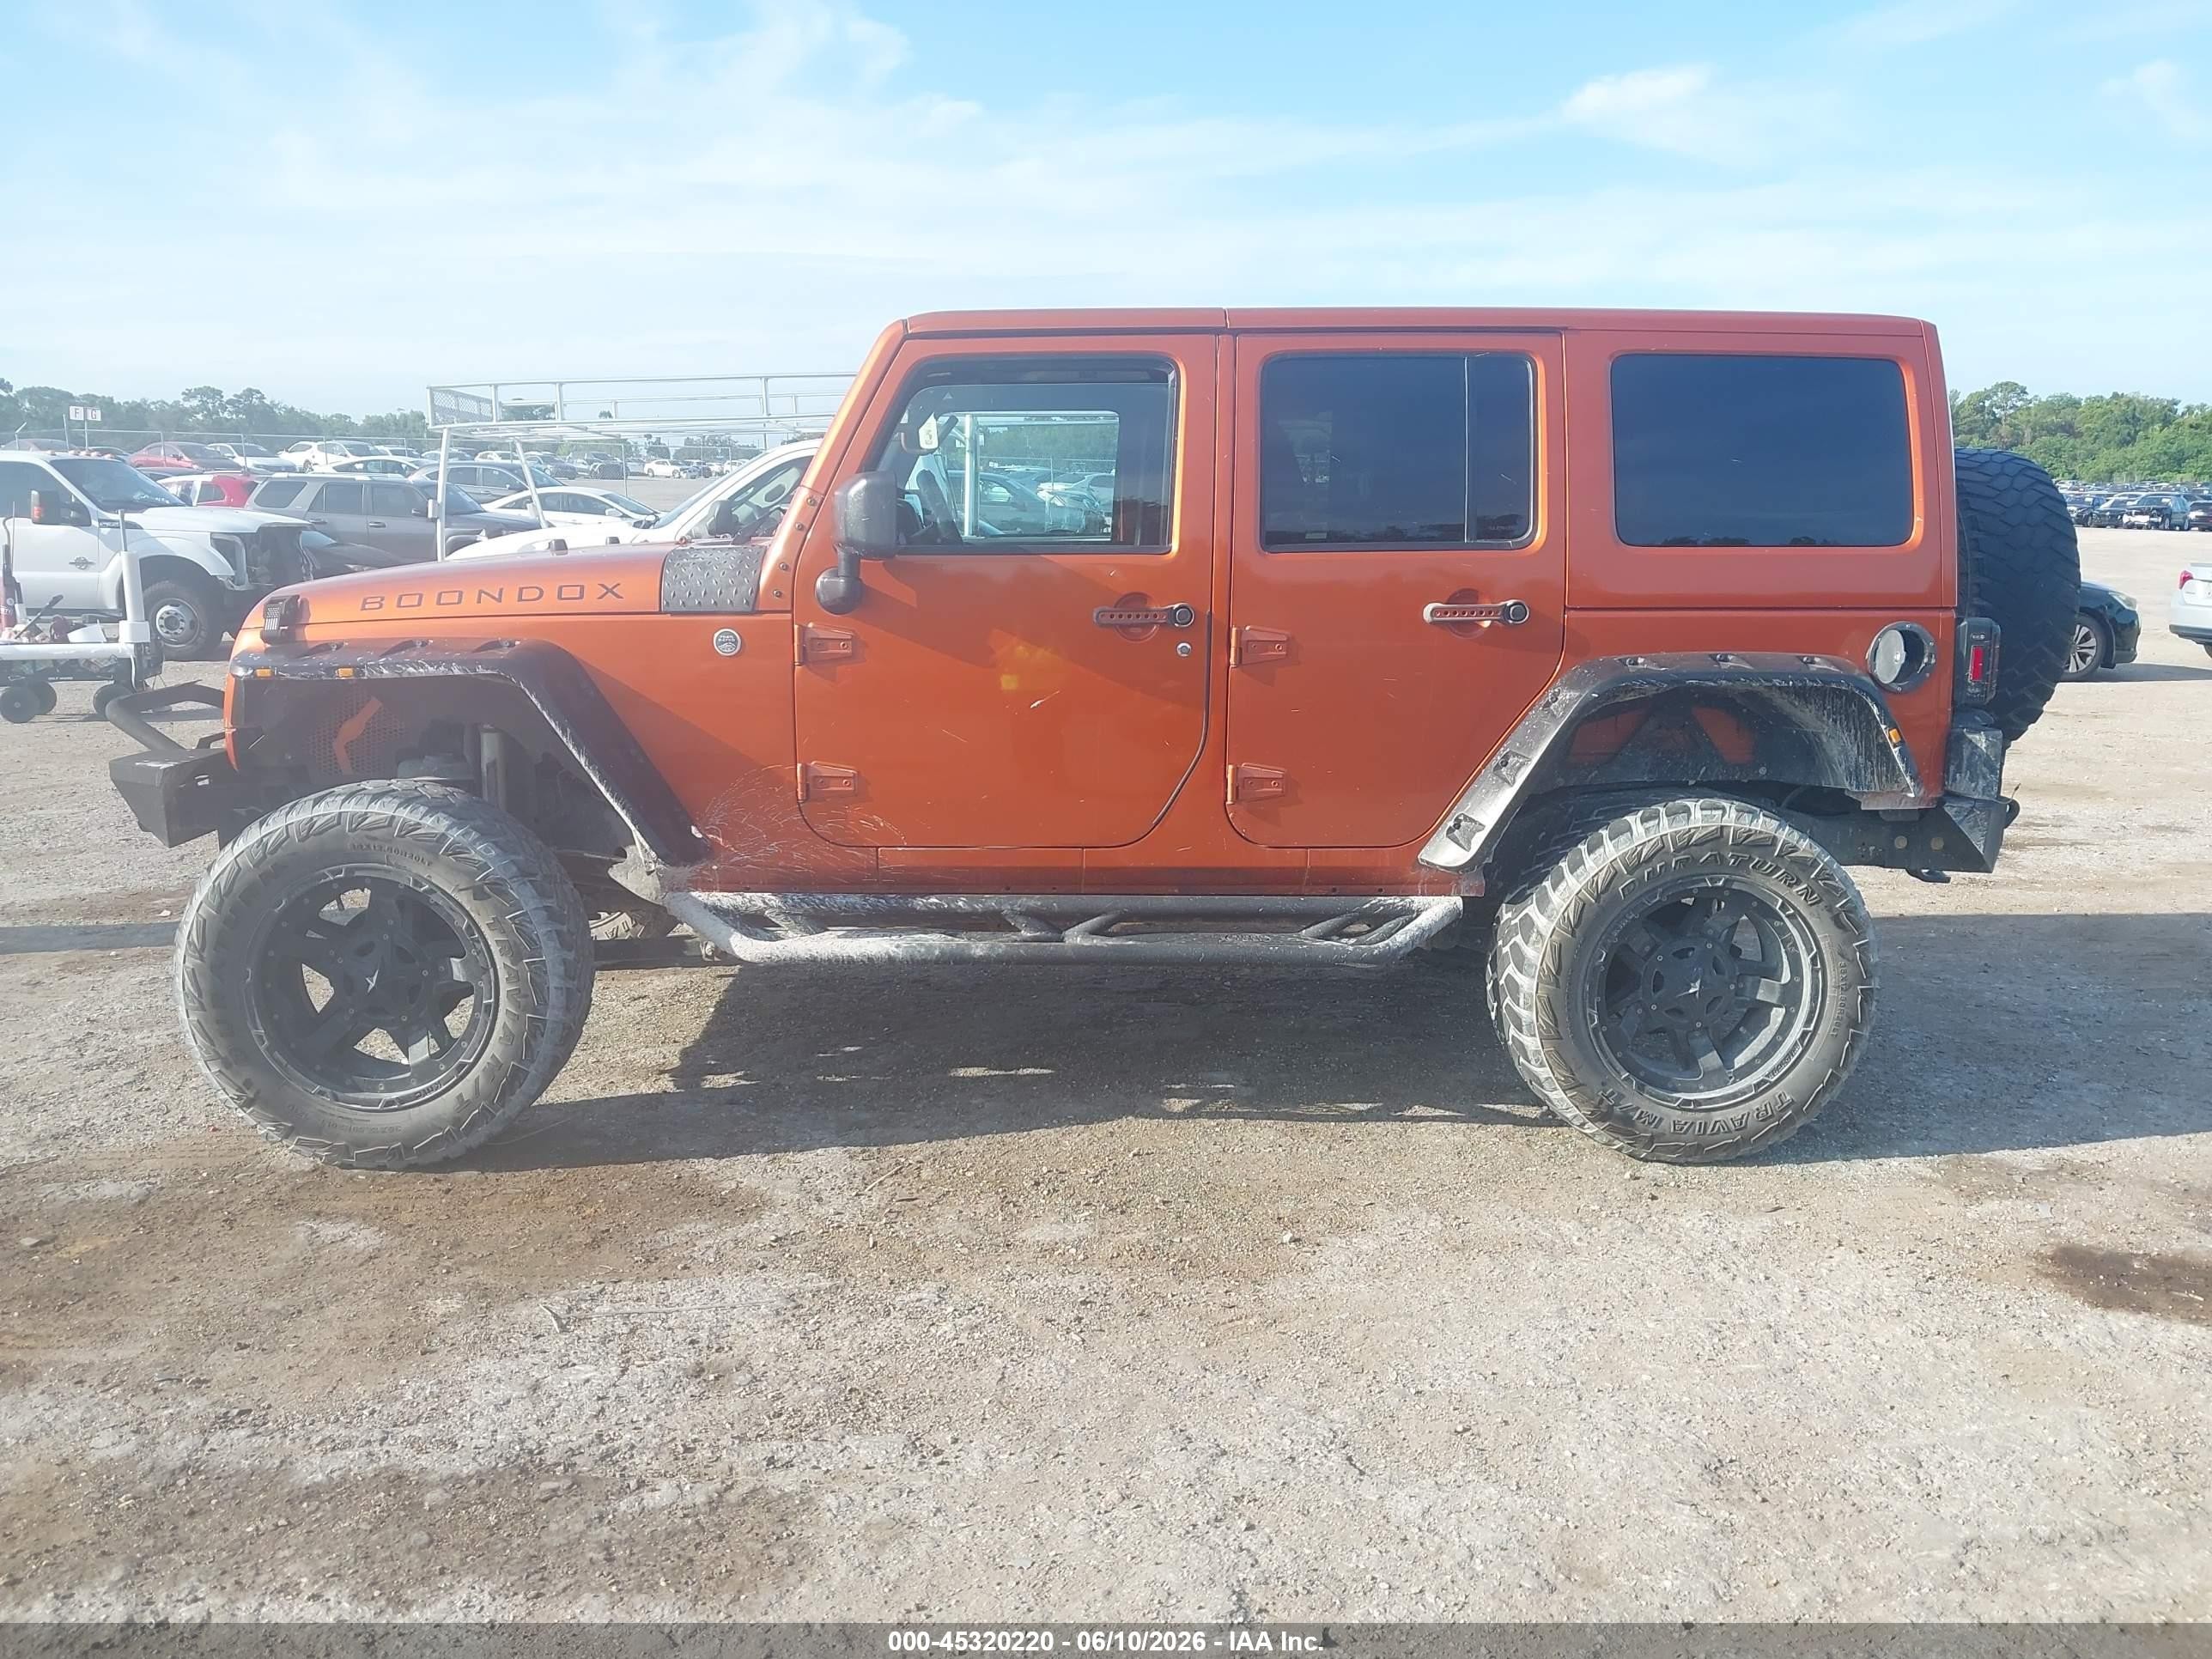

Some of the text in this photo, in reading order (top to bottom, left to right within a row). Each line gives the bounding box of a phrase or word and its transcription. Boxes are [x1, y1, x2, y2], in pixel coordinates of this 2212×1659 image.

[74, 408, 80, 419] F
[90, 408, 97, 420] G
[361, 583, 624, 611] BOONDOX
[1618, 850, 1821, 907] DURATURN
[486, 915, 521, 1046] TRAVIA
[1597, 1087, 1795, 1135] TRAVIA M/T
